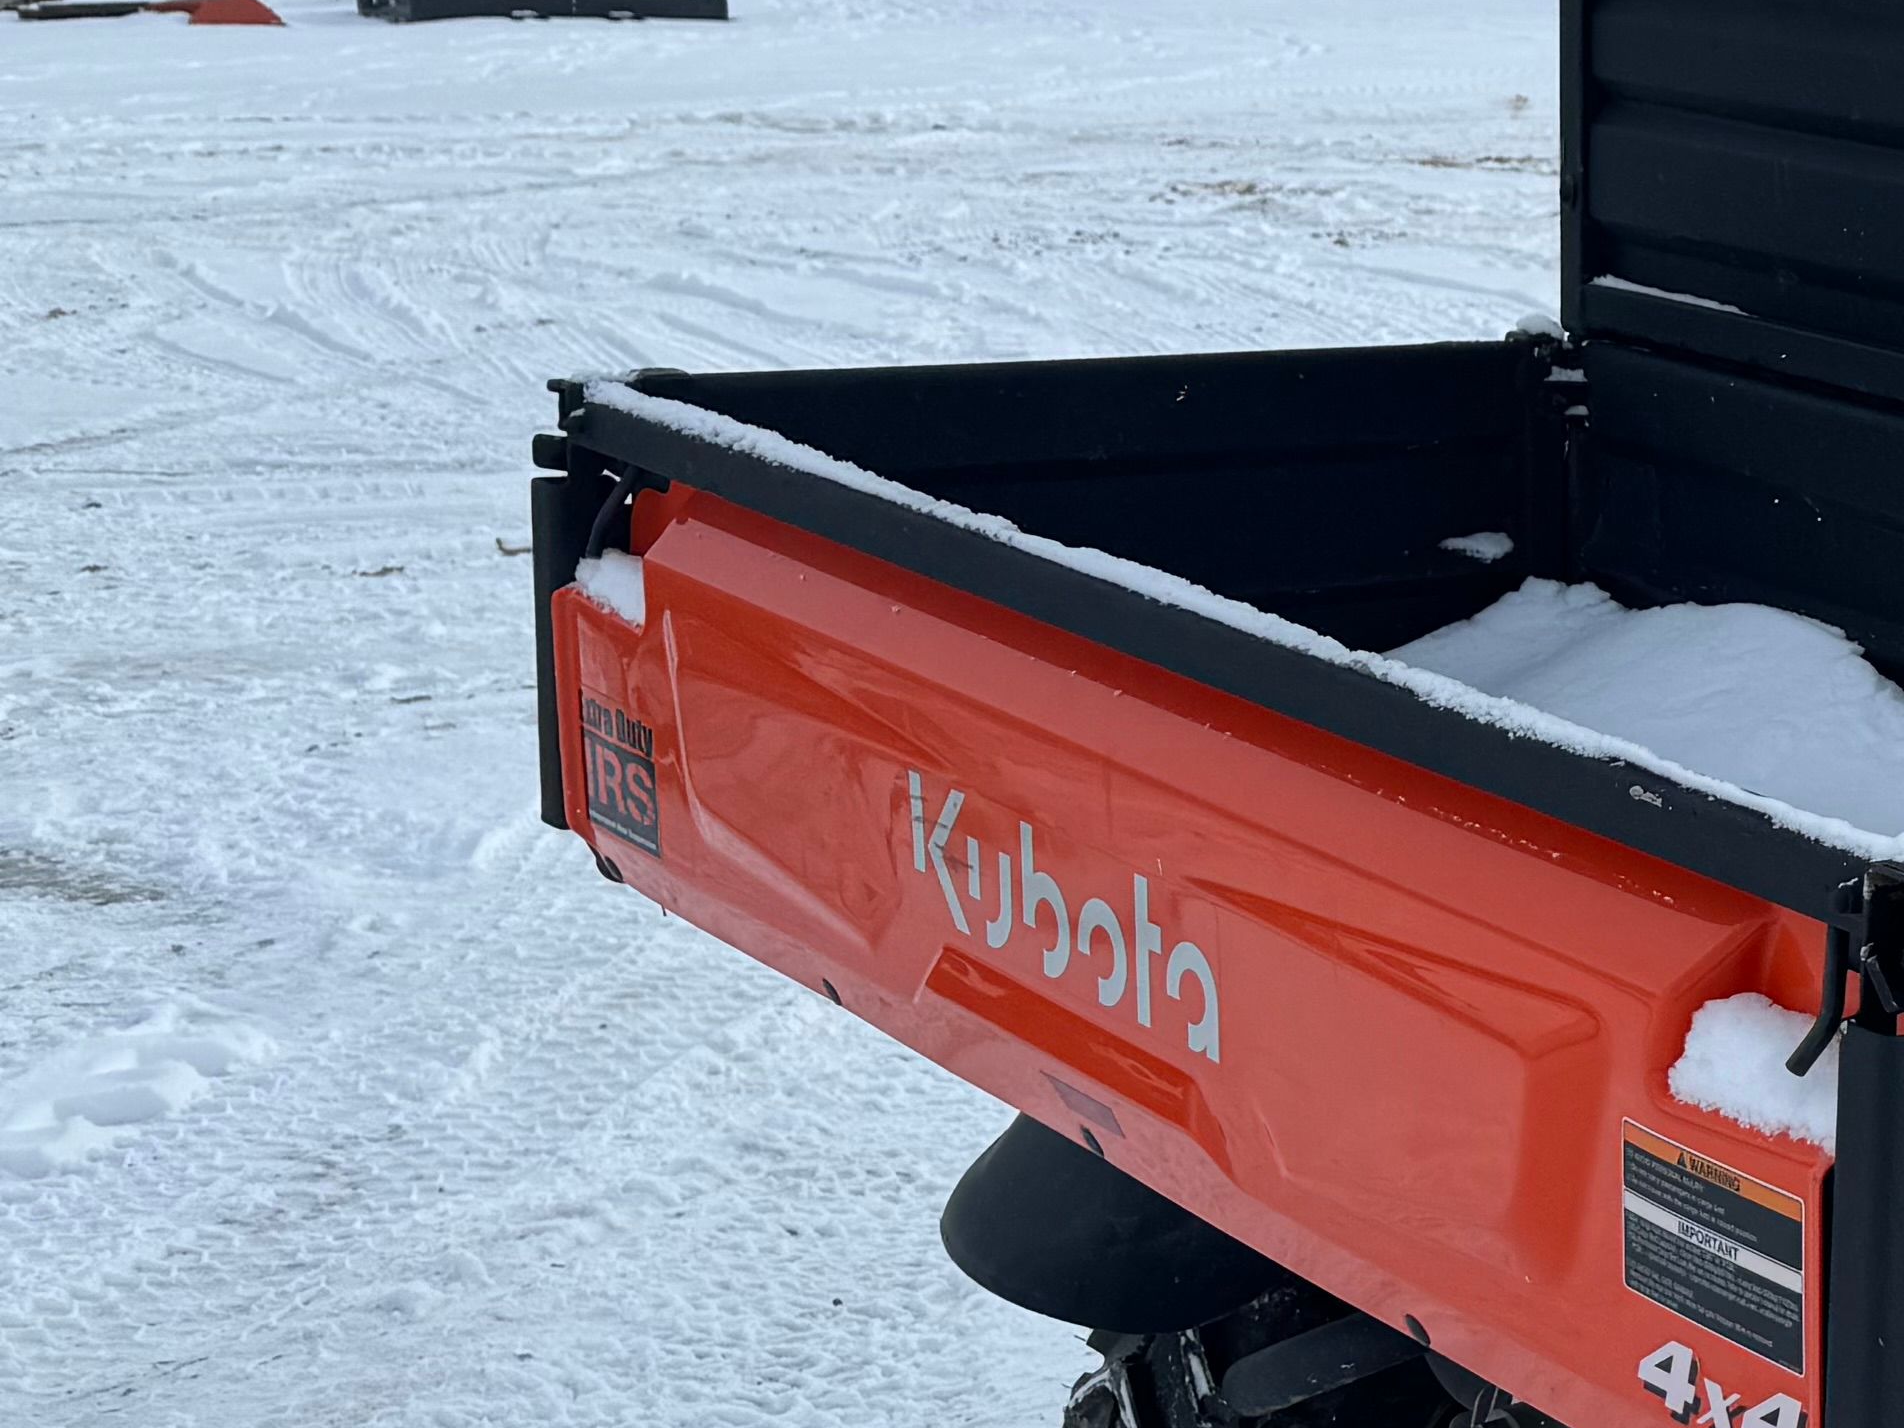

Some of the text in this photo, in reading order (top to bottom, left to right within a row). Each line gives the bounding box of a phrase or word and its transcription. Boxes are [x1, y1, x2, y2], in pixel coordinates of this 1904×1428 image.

[615, 708, 654, 758] Duty
[584, 735, 656, 826] IRS
[907, 769, 1222, 1064] Kubota
[1689, 1155, 1741, 1193] WARNING
[1678, 1220, 1740, 1260] IMPORTANT
